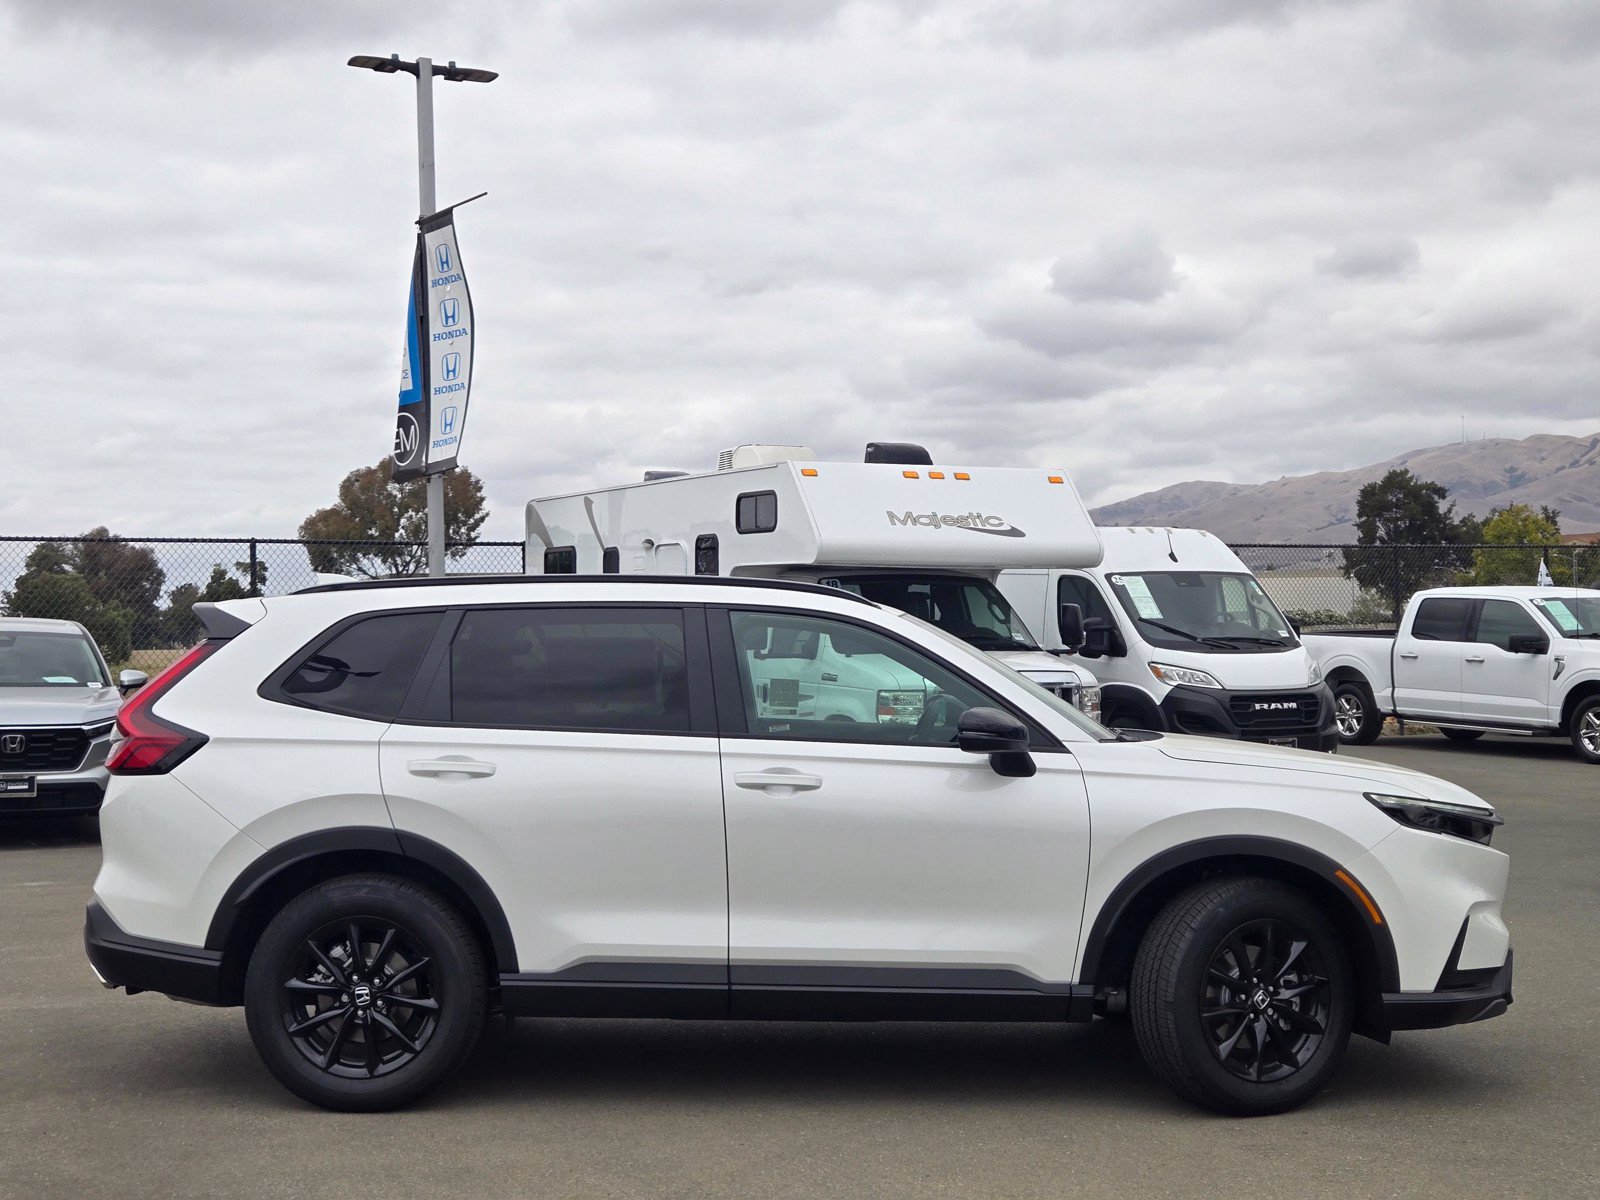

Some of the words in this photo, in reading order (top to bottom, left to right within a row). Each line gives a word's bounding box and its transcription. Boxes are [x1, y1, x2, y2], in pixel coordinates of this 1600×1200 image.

[431, 273, 462, 288] HONDA
[433, 328, 468, 341] HONDA
[433, 382, 466, 395] HONDA
[432, 436, 458, 449] HONDA
[886, 510, 1004, 529] Majestic
[1254, 702, 1297, 710] RAM
